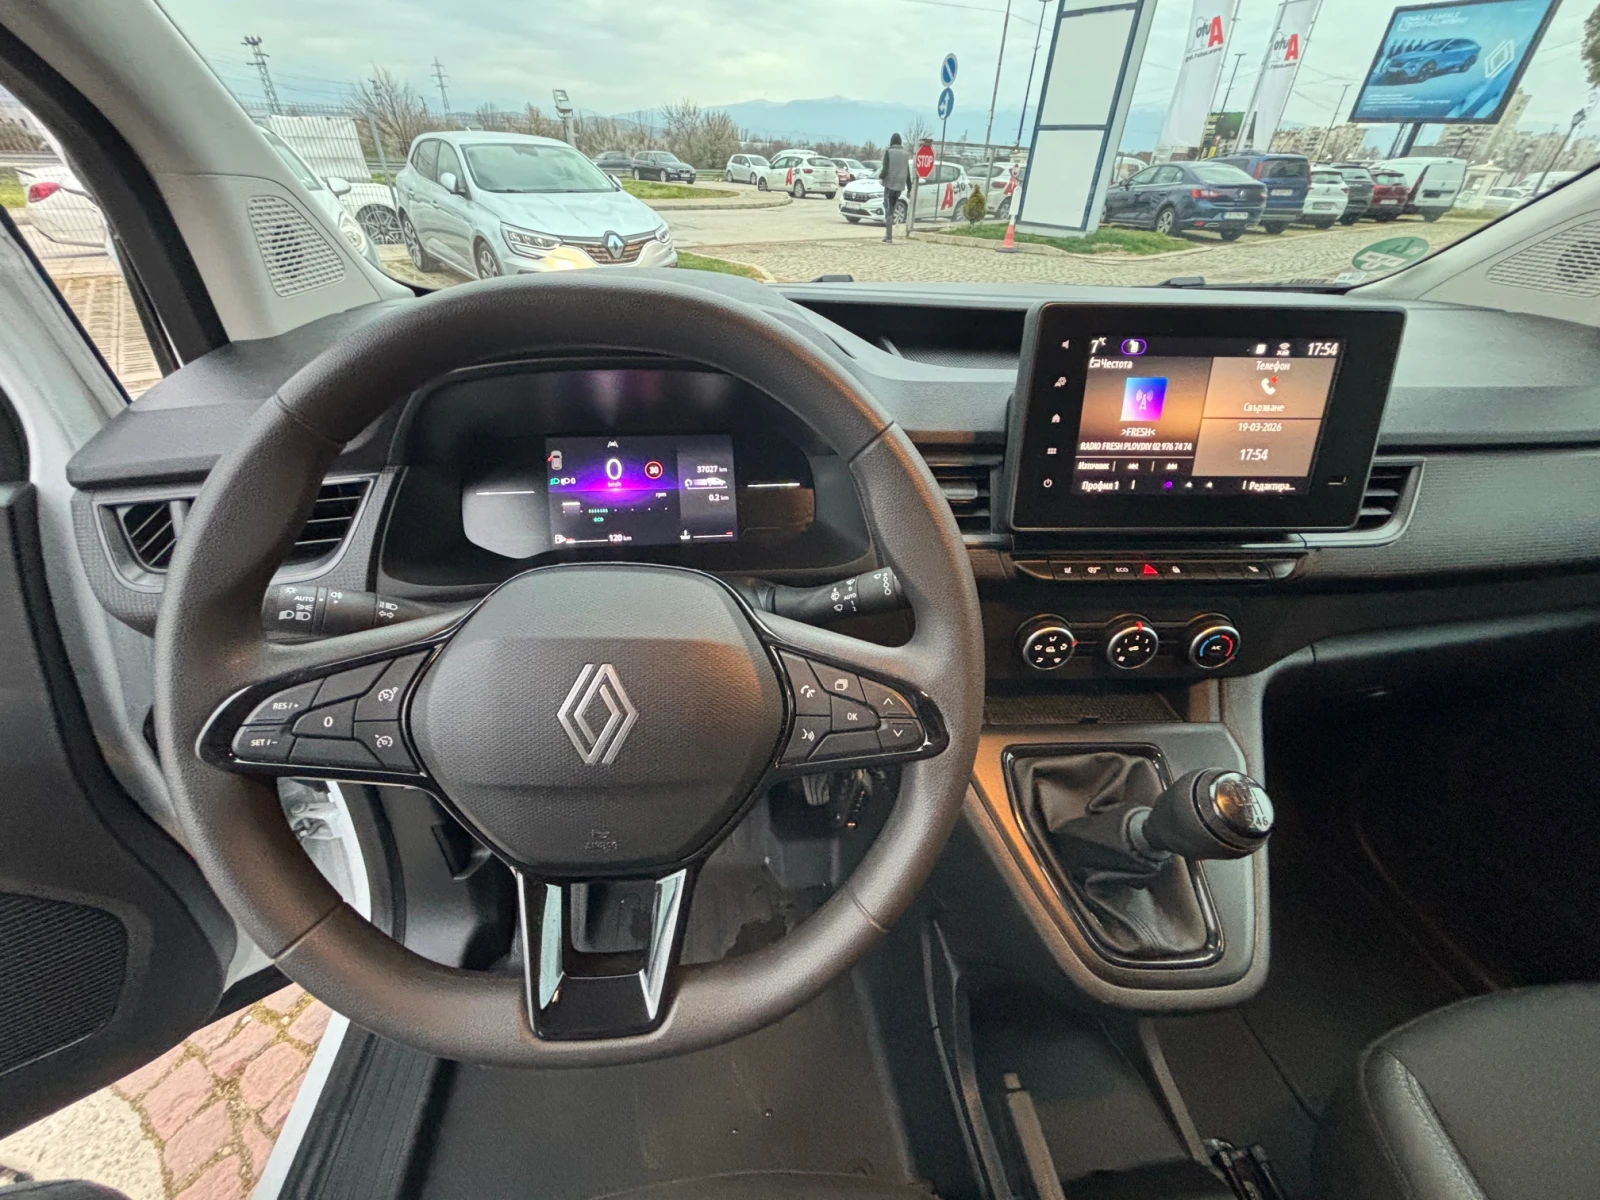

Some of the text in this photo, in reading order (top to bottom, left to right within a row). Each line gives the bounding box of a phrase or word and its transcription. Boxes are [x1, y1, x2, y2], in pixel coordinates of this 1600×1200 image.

[917, 155, 934, 168] STOP
[1308, 342, 1339, 356] 17:54
[1101, 359, 1133, 369] Честота
[1256, 361, 1291, 372] Телефон
[1243, 403, 1285, 413] Свързване
[1238, 423, 1282, 432] 19-03-2026
[1080, 442, 1101, 451] RADIO
[1102, 442, 1122, 451] FRESH
[1124, 442, 1152, 451] PLOVDIV
[1240, 448, 1269, 461] 17:54
[606, 459, 622, 480] 0
[696, 465, 718, 473] 37027
[608, 533, 623, 542] 120
[844, 592, 856, 600] AUTO
[272, 702, 287, 710] RES
[847, 712, 858, 721] OK
[250, 739, 265, 747] SET
